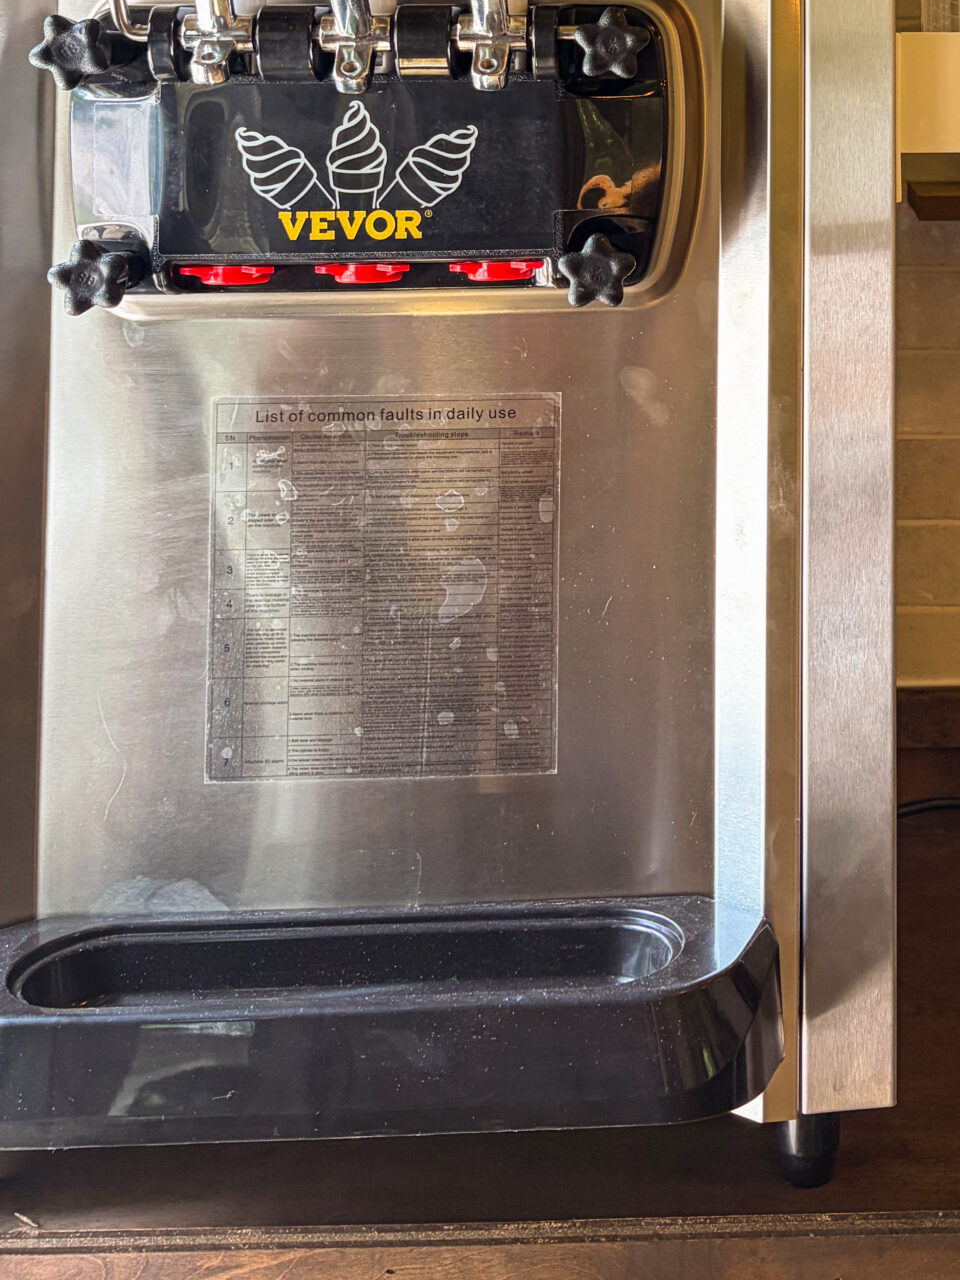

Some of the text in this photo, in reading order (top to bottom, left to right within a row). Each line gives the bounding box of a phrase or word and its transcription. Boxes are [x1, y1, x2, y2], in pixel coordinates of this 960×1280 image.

[278, 210, 423, 241] VEVOR
[256, 407, 516, 423] List of common faults in daily use
[228, 517, 234, 525] 2
[226, 566, 233, 574] 3
[226, 599, 232, 608] 4
[224, 644, 230, 653] 5
[224, 698, 231, 707] 6
[224, 758, 229, 767] 7
